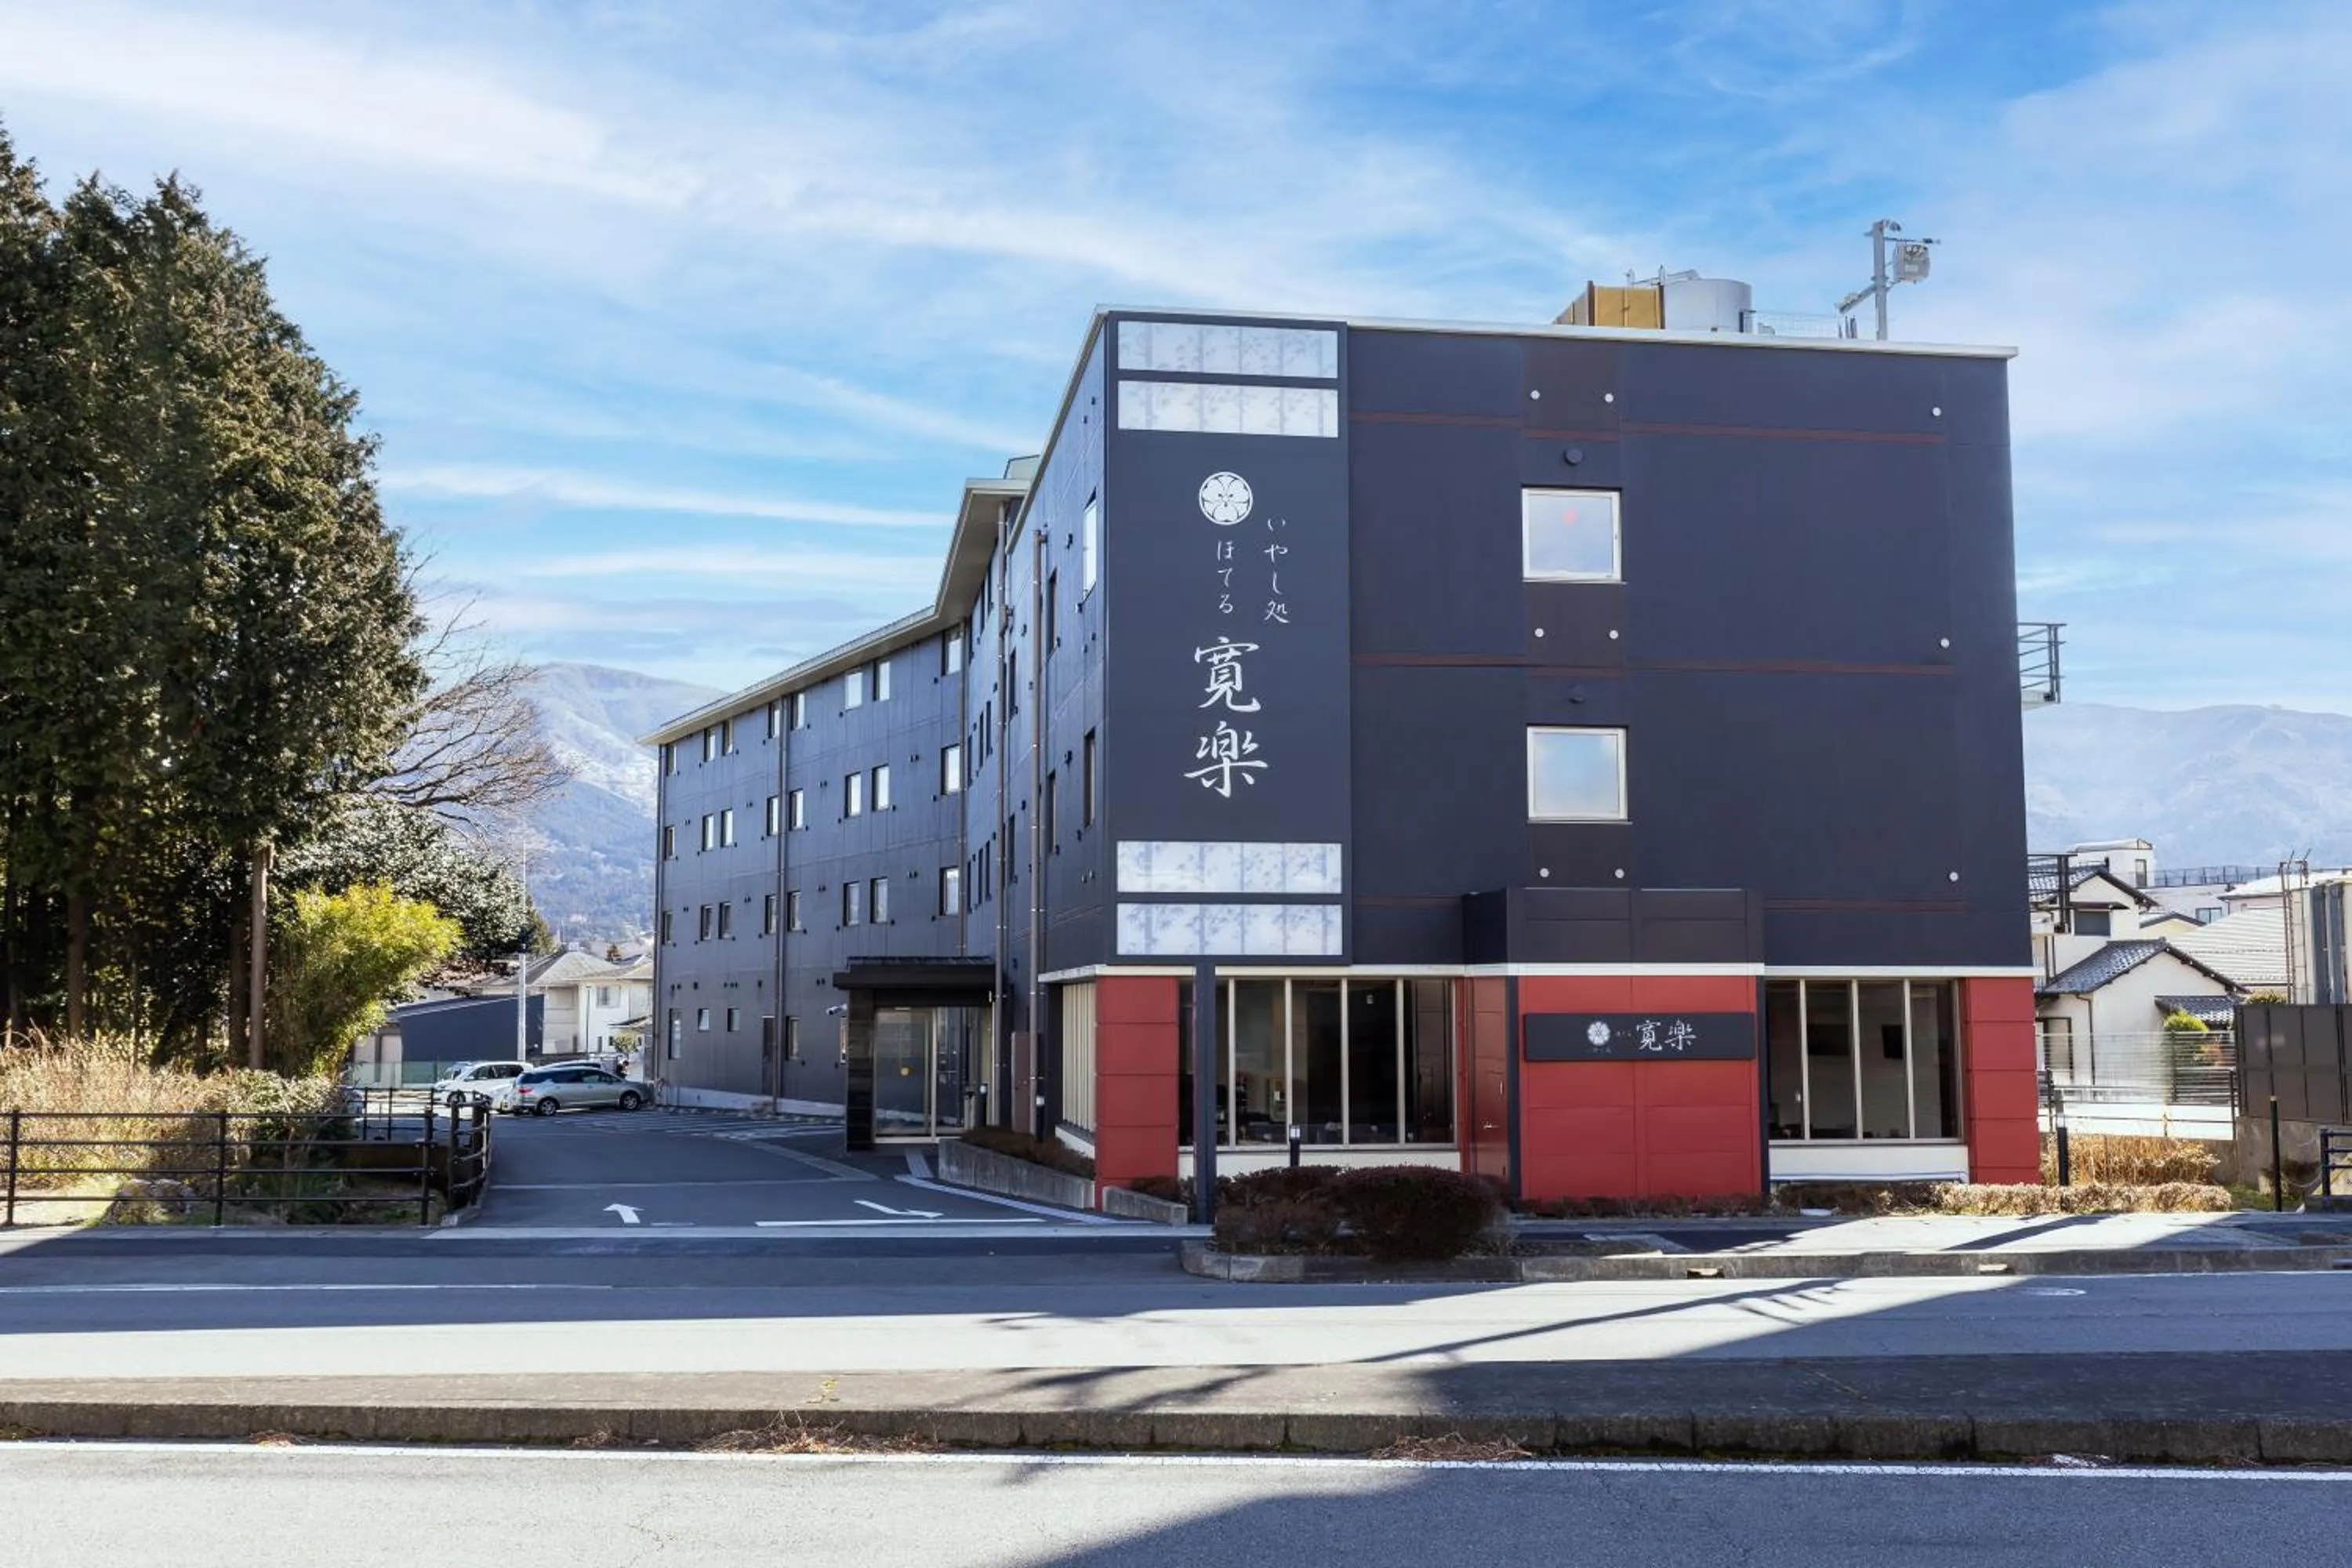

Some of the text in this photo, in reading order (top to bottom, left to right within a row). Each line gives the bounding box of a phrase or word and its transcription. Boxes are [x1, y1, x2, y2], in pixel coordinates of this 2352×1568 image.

[1216, 540, 1235, 615] ほてる
[1263, 517, 1290, 624] いやし処
[1183, 636, 1269, 798] 寛楽
[1636, 1018, 1697, 1051] 寛楽
